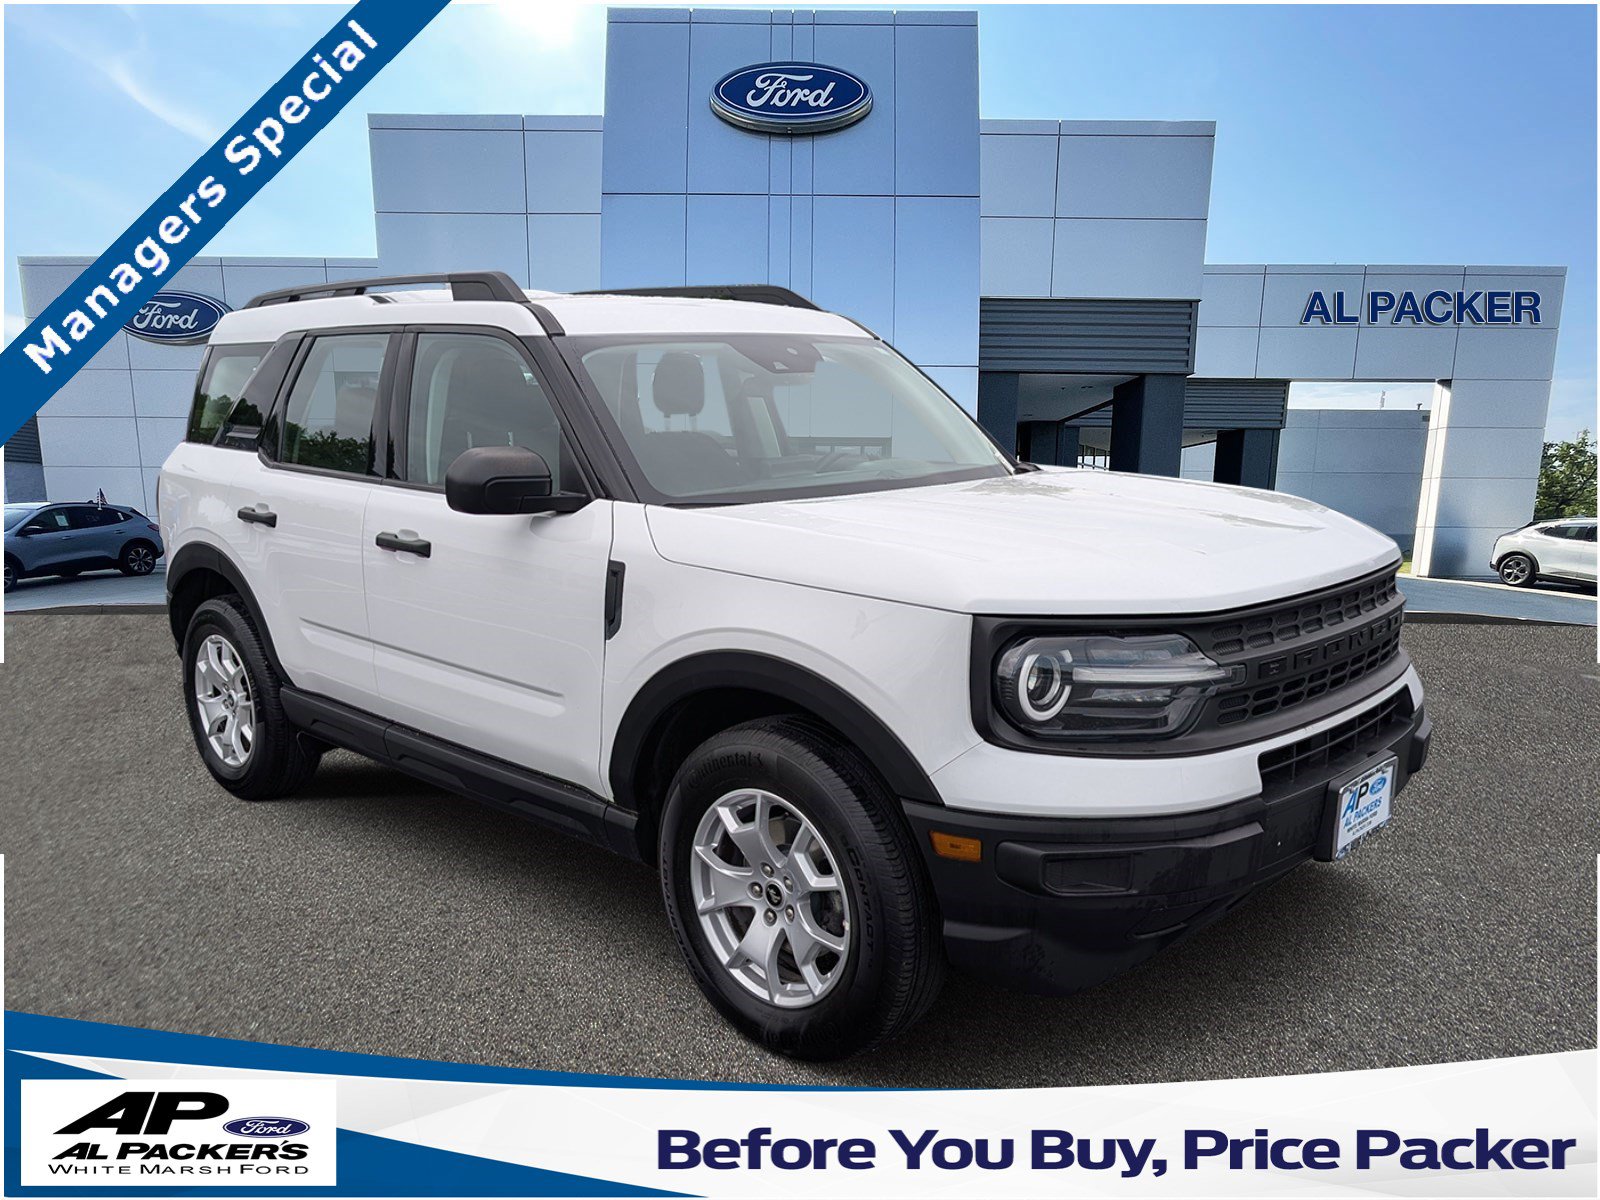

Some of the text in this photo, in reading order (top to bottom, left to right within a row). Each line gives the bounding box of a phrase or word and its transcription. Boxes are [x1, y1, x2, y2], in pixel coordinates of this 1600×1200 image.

[746, 73, 836, 108] Ford
[133, 301, 199, 330] Ford
[1301, 290, 1542, 324] AL PACKER
[1258, 610, 1402, 680] BRONCO
[1341, 781, 1370, 820] AP
